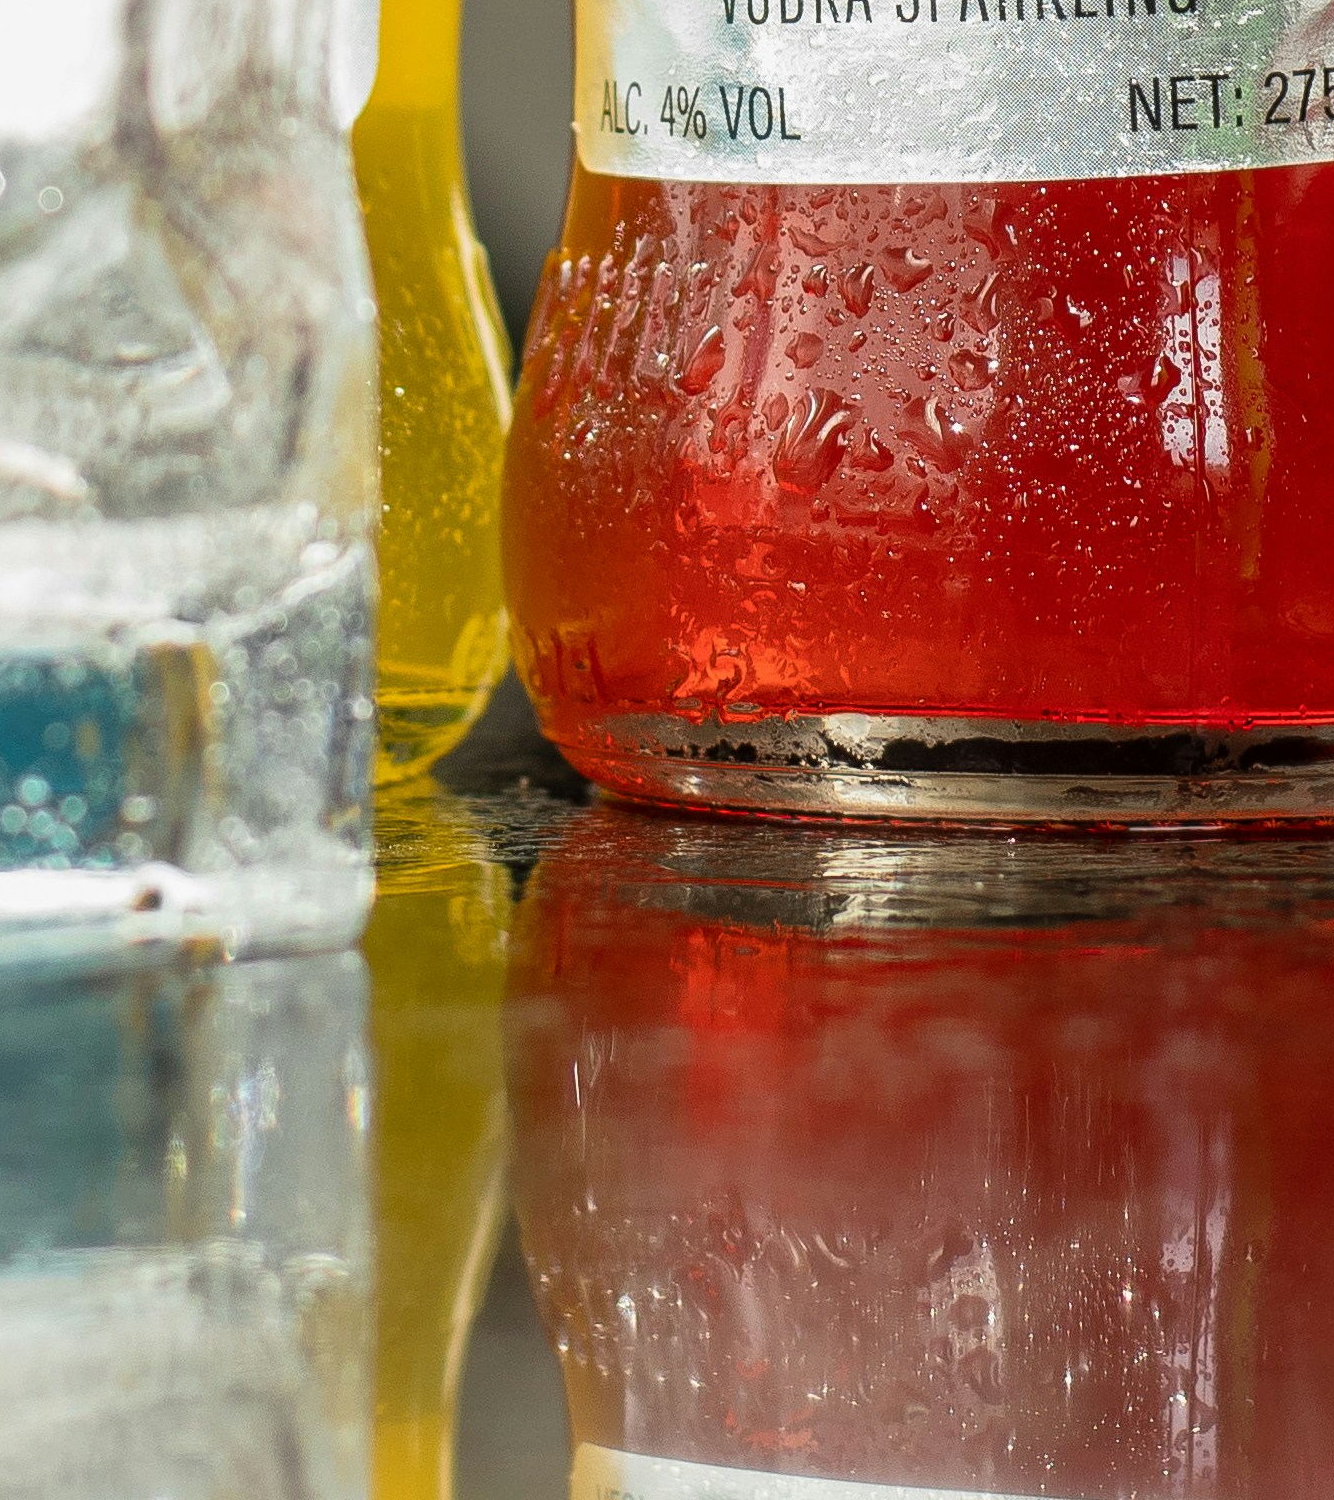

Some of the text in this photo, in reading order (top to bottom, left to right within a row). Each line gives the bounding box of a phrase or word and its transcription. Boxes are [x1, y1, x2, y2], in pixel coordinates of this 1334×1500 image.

[600, 78, 802, 141] ALC. 4% VOL
[1128, 73, 1244, 133] NET:
